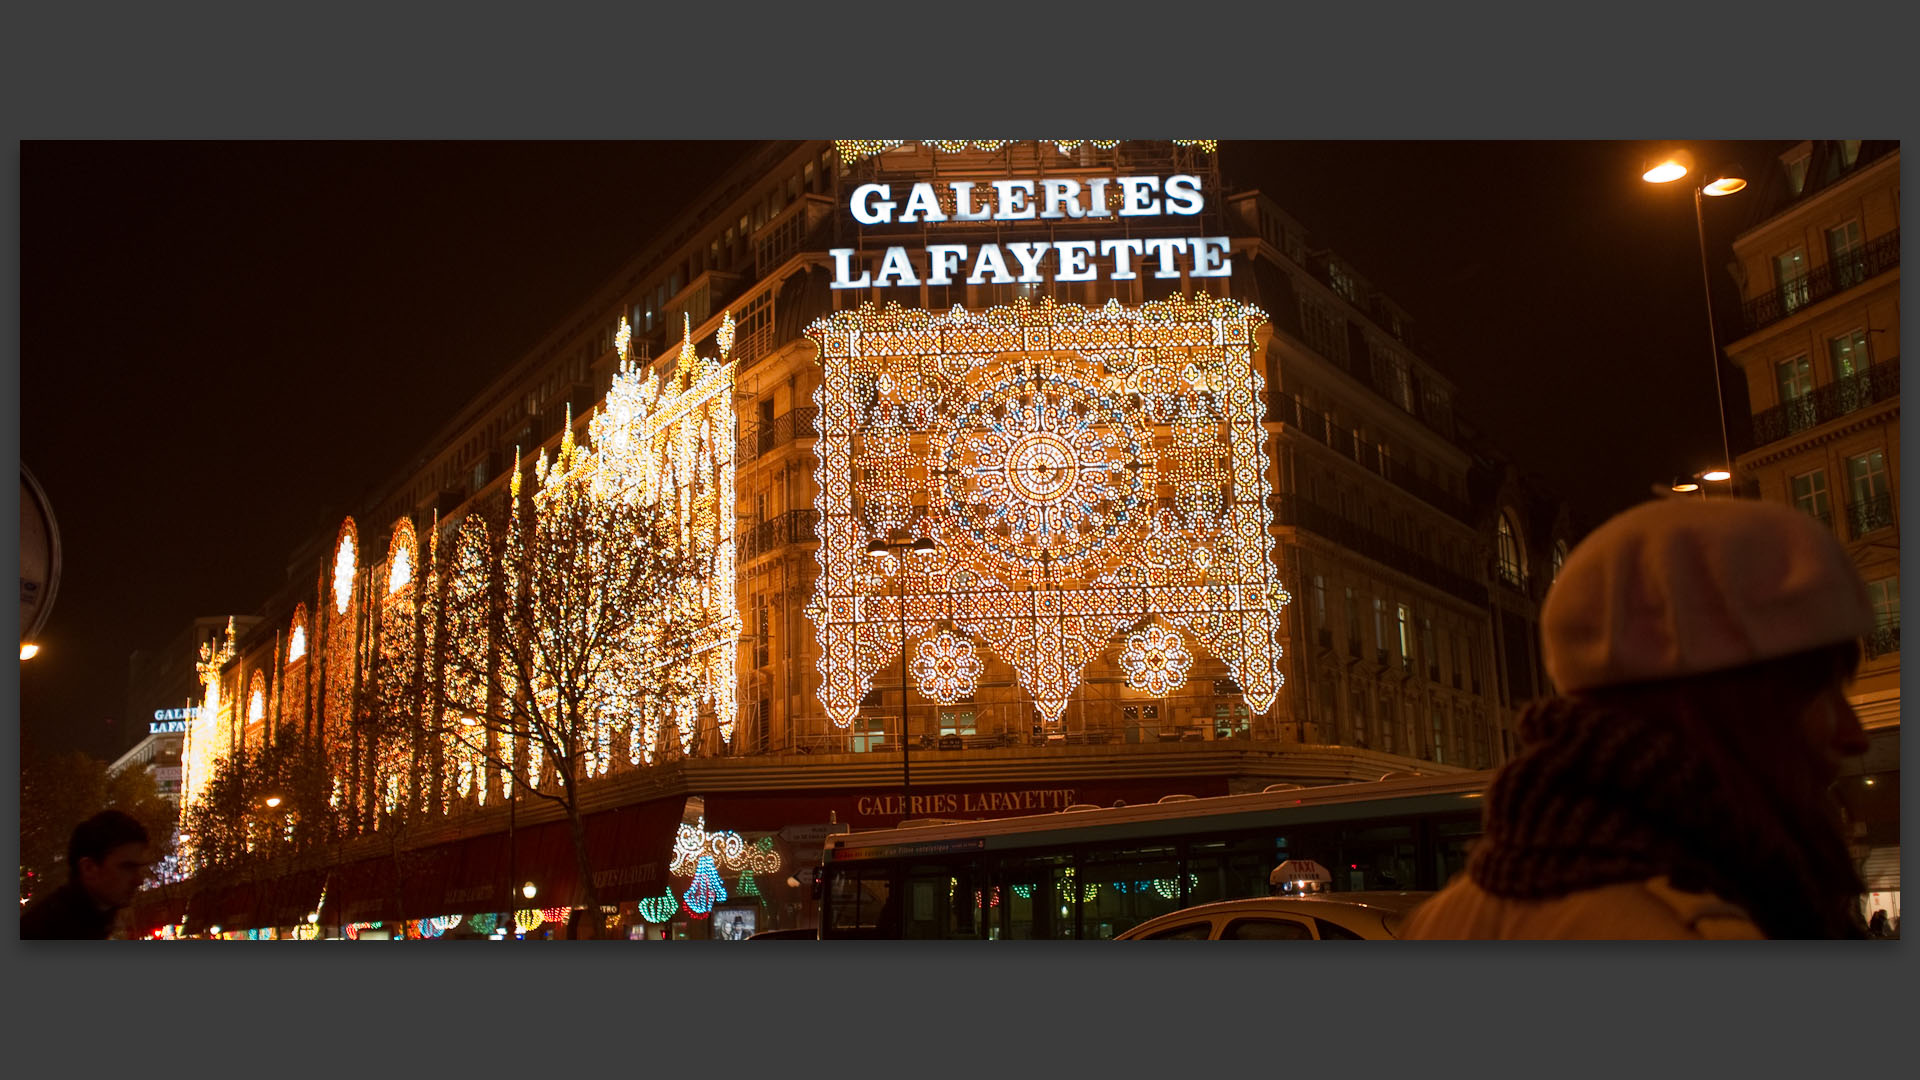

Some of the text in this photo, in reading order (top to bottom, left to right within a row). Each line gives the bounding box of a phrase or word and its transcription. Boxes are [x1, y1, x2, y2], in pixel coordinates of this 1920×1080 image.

[849, 174, 1205, 225] GALERIES
[829, 236, 1233, 290] LAFAYETTE
[154, 707, 198, 721] GALER
[857, 789, 1076, 816] GALERIES LAFAYETTE
[1291, 861, 1315, 872] TAXI
[600, 905, 618, 914] TRO
